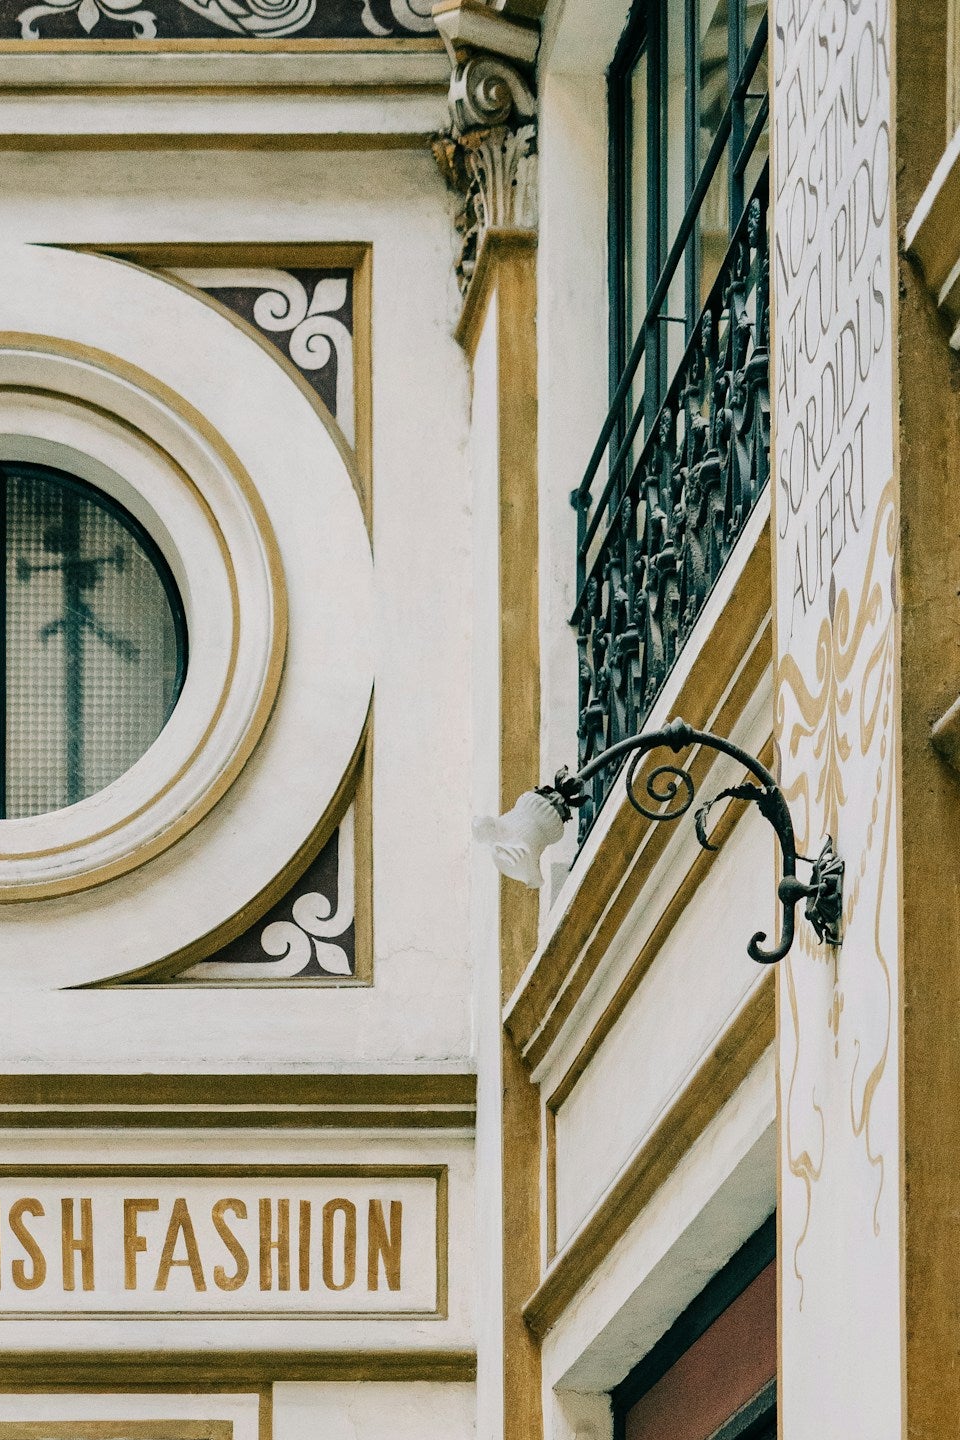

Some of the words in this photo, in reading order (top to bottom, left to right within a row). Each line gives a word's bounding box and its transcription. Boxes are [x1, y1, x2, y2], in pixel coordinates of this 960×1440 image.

[805, 120, 890, 363] CUPIDO
[780, 252, 885, 539] SORDIDUS
[790, 403, 870, 638] AUFERT
[124, 1198, 402, 1292] FASHION
